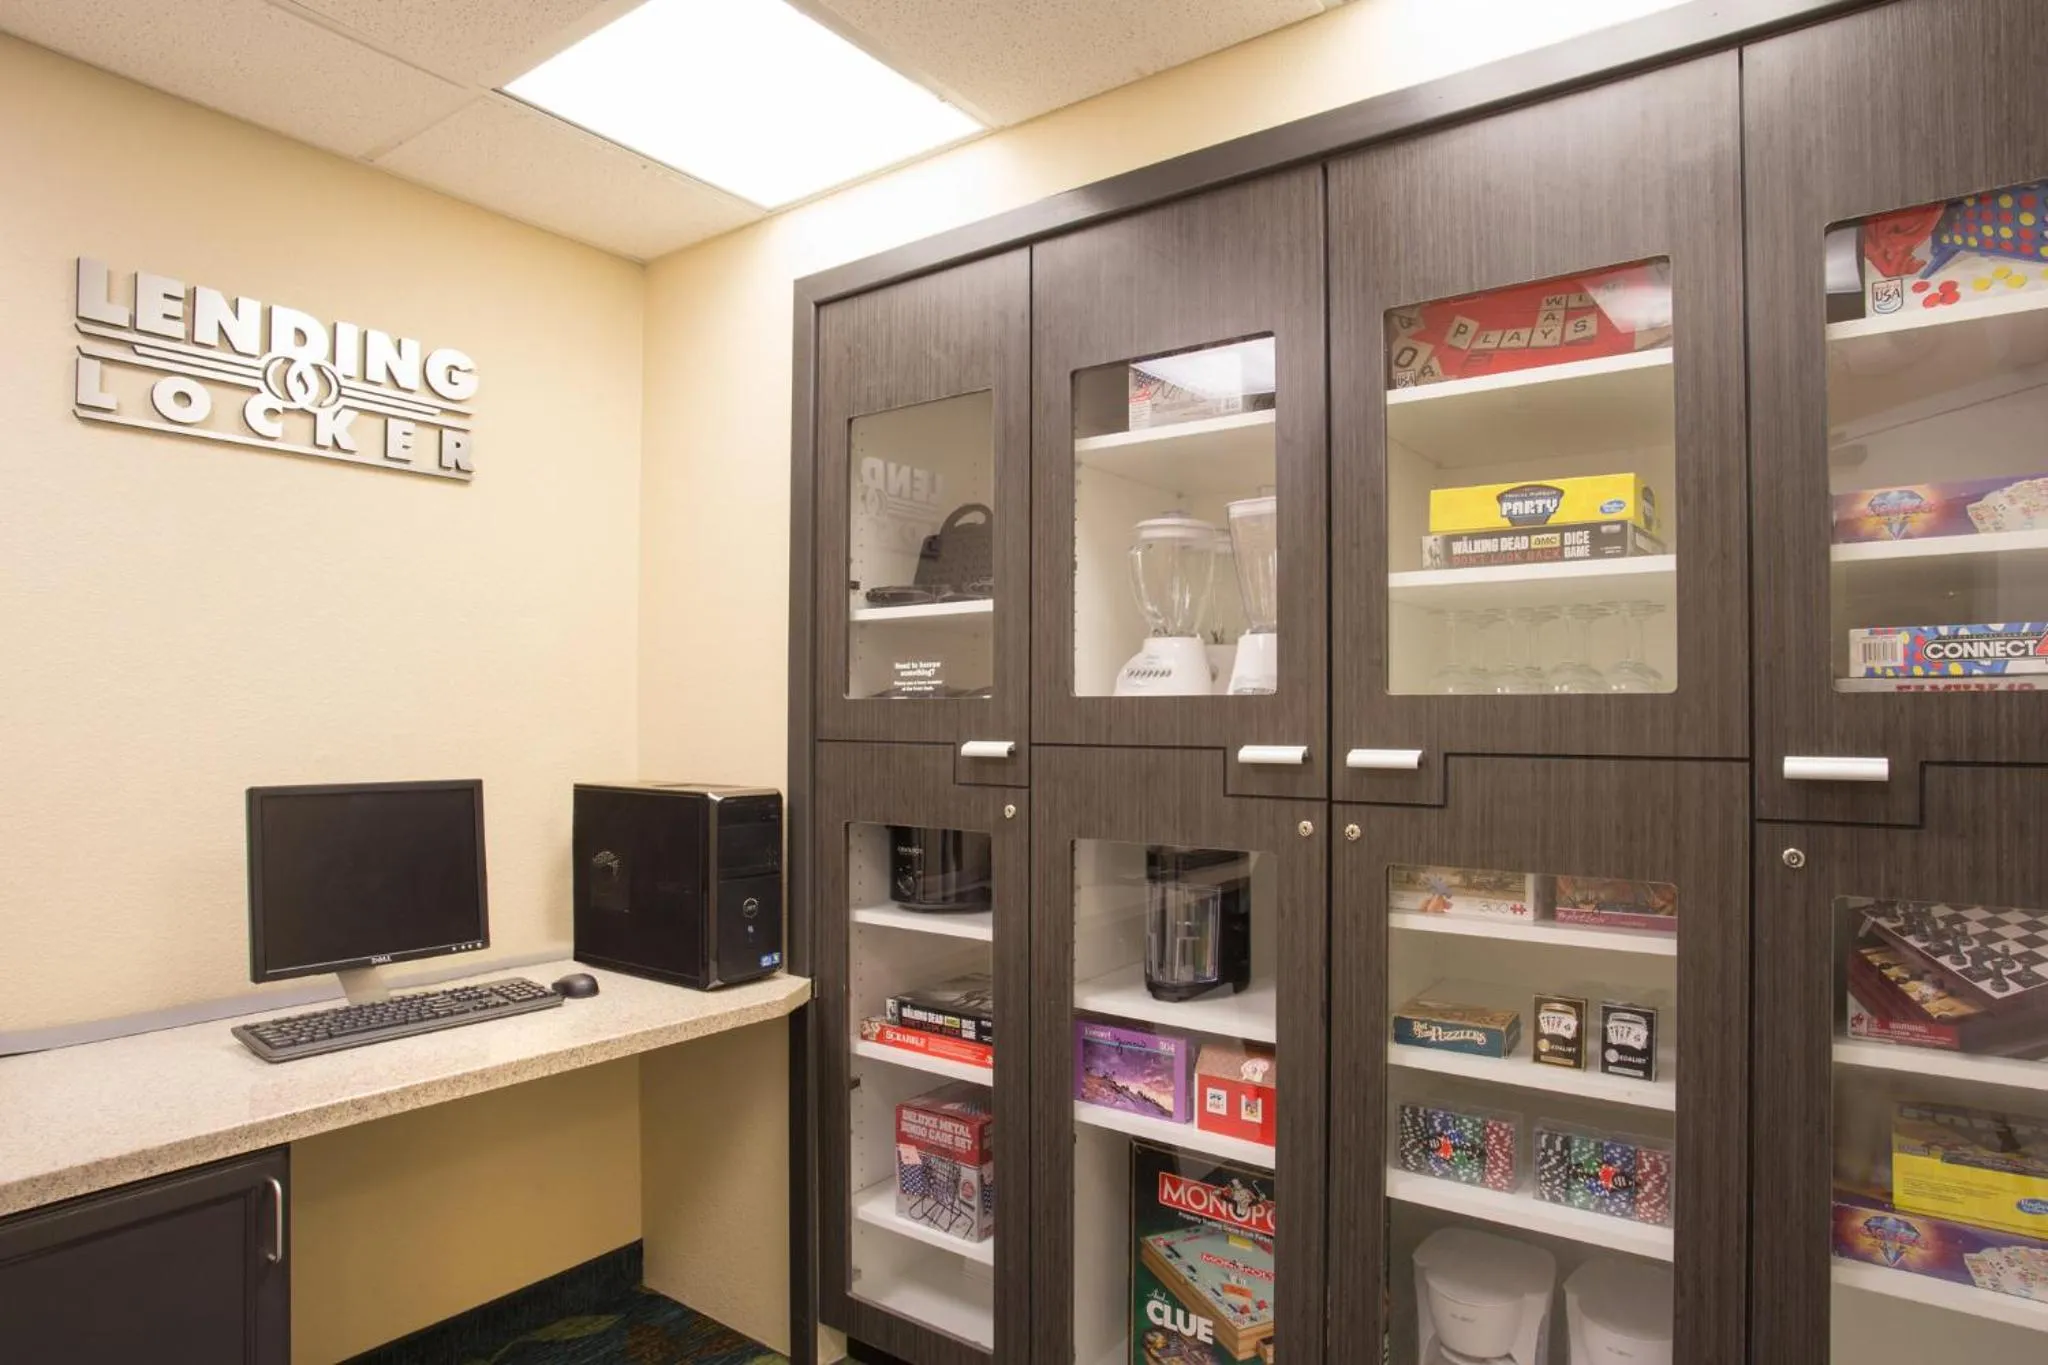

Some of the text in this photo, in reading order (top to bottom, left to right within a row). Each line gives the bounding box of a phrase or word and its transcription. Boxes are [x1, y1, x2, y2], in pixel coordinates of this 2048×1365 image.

[1875, 287, 1901, 302] USA
[76, 256, 479, 402] LENDING
[76, 356, 475, 472] LOCKER
[1501, 498, 1558, 516] PARTY
[1451, 535, 1529, 555] WALKING DEAD
[1564, 530, 1590, 546] DICE
[1564, 545, 1590, 559] GAME
[1926, 640, 2038, 659] CONNECT
[371, 955, 392, 964] DELL
[885, 1030, 926, 1048] SCRABBLE
[1146, 1300, 1214, 1345] CLUE
